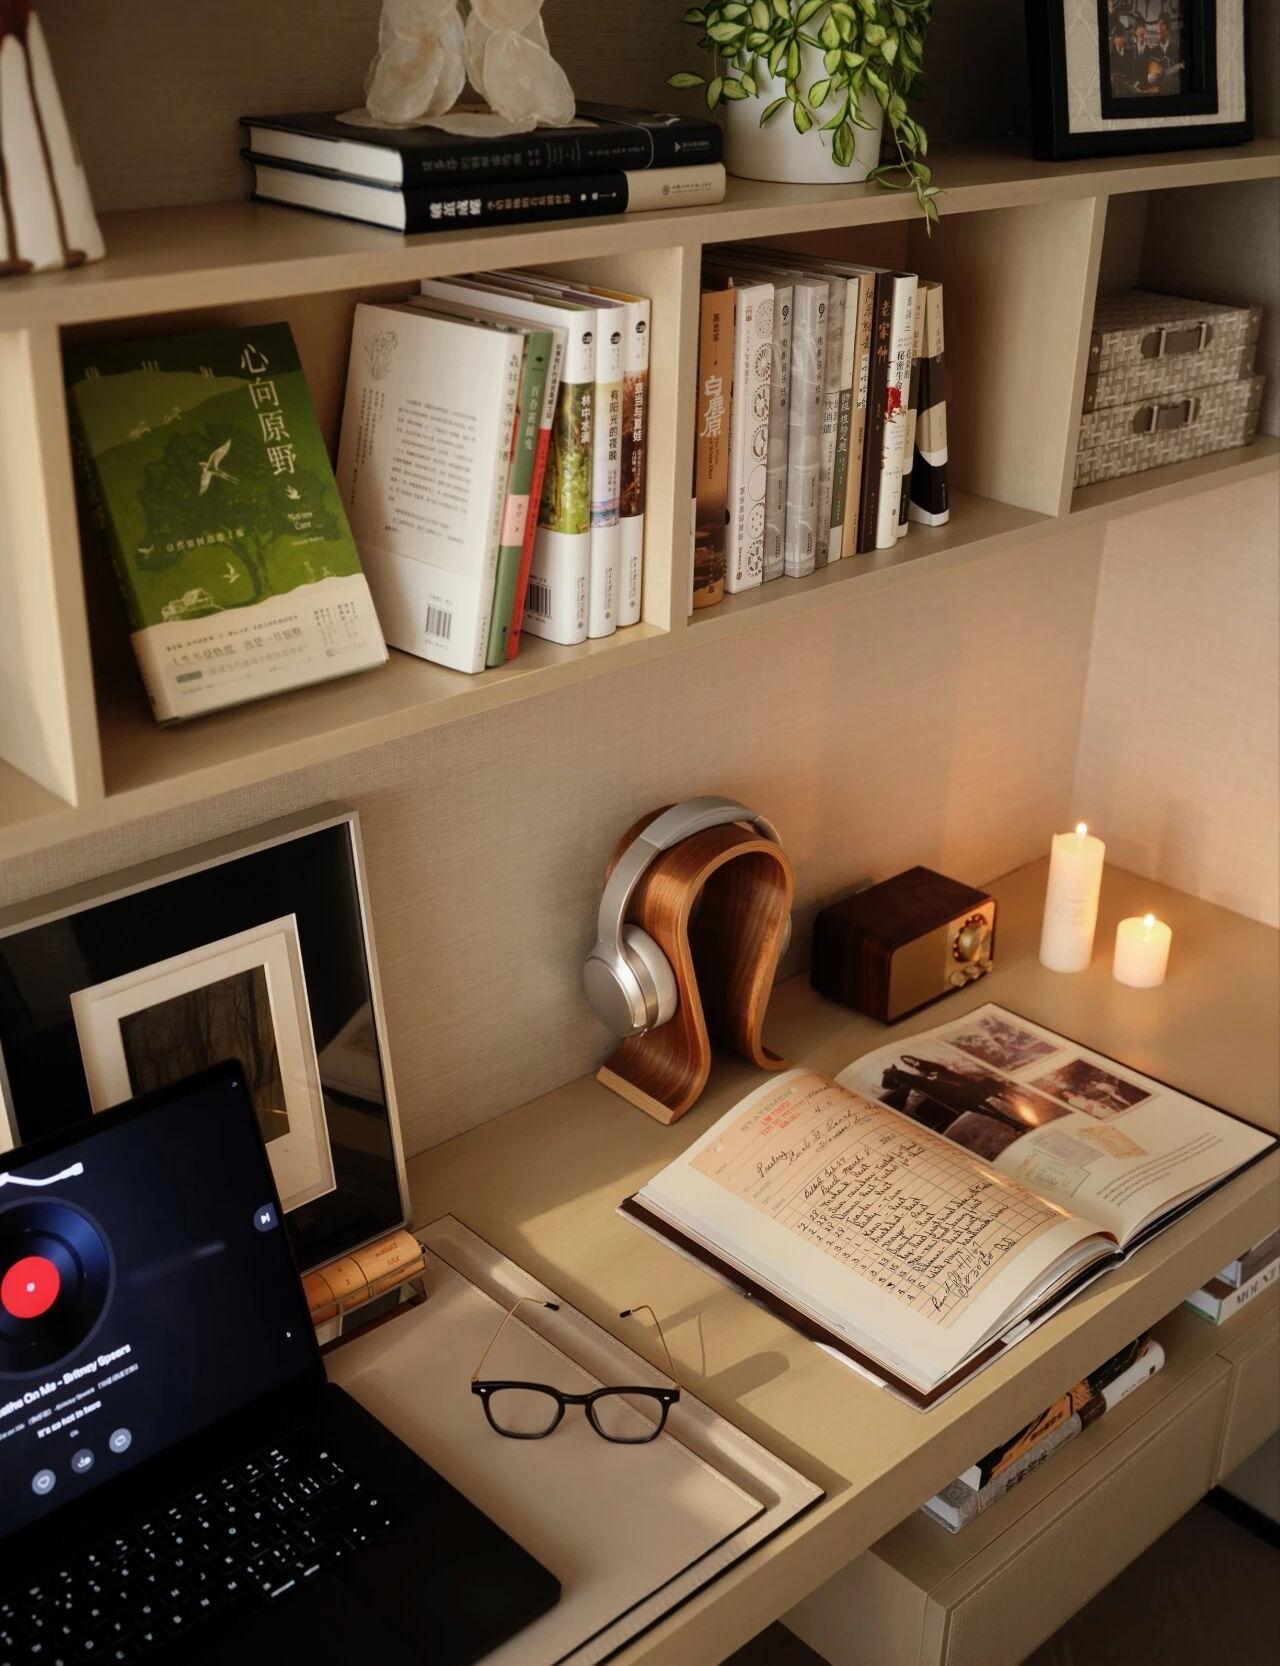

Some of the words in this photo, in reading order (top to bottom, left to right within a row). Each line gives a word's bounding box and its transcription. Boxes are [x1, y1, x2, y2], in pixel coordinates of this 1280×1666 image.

[241, 343, 297, 476] 心向原野
[580, 394, 592, 445] 林中水滴
[607, 389, 619, 461] 有阳光的夜晚
[633, 383, 645, 443] 亚当与夏娃
[700, 375, 725, 437] 白鹿原
[21, 1388, 41, 1404] On
[38, 1379, 57, 1396] Me
[61, 1359, 99, 1385] Britney
[95, 1342, 132, 1367] Spears
